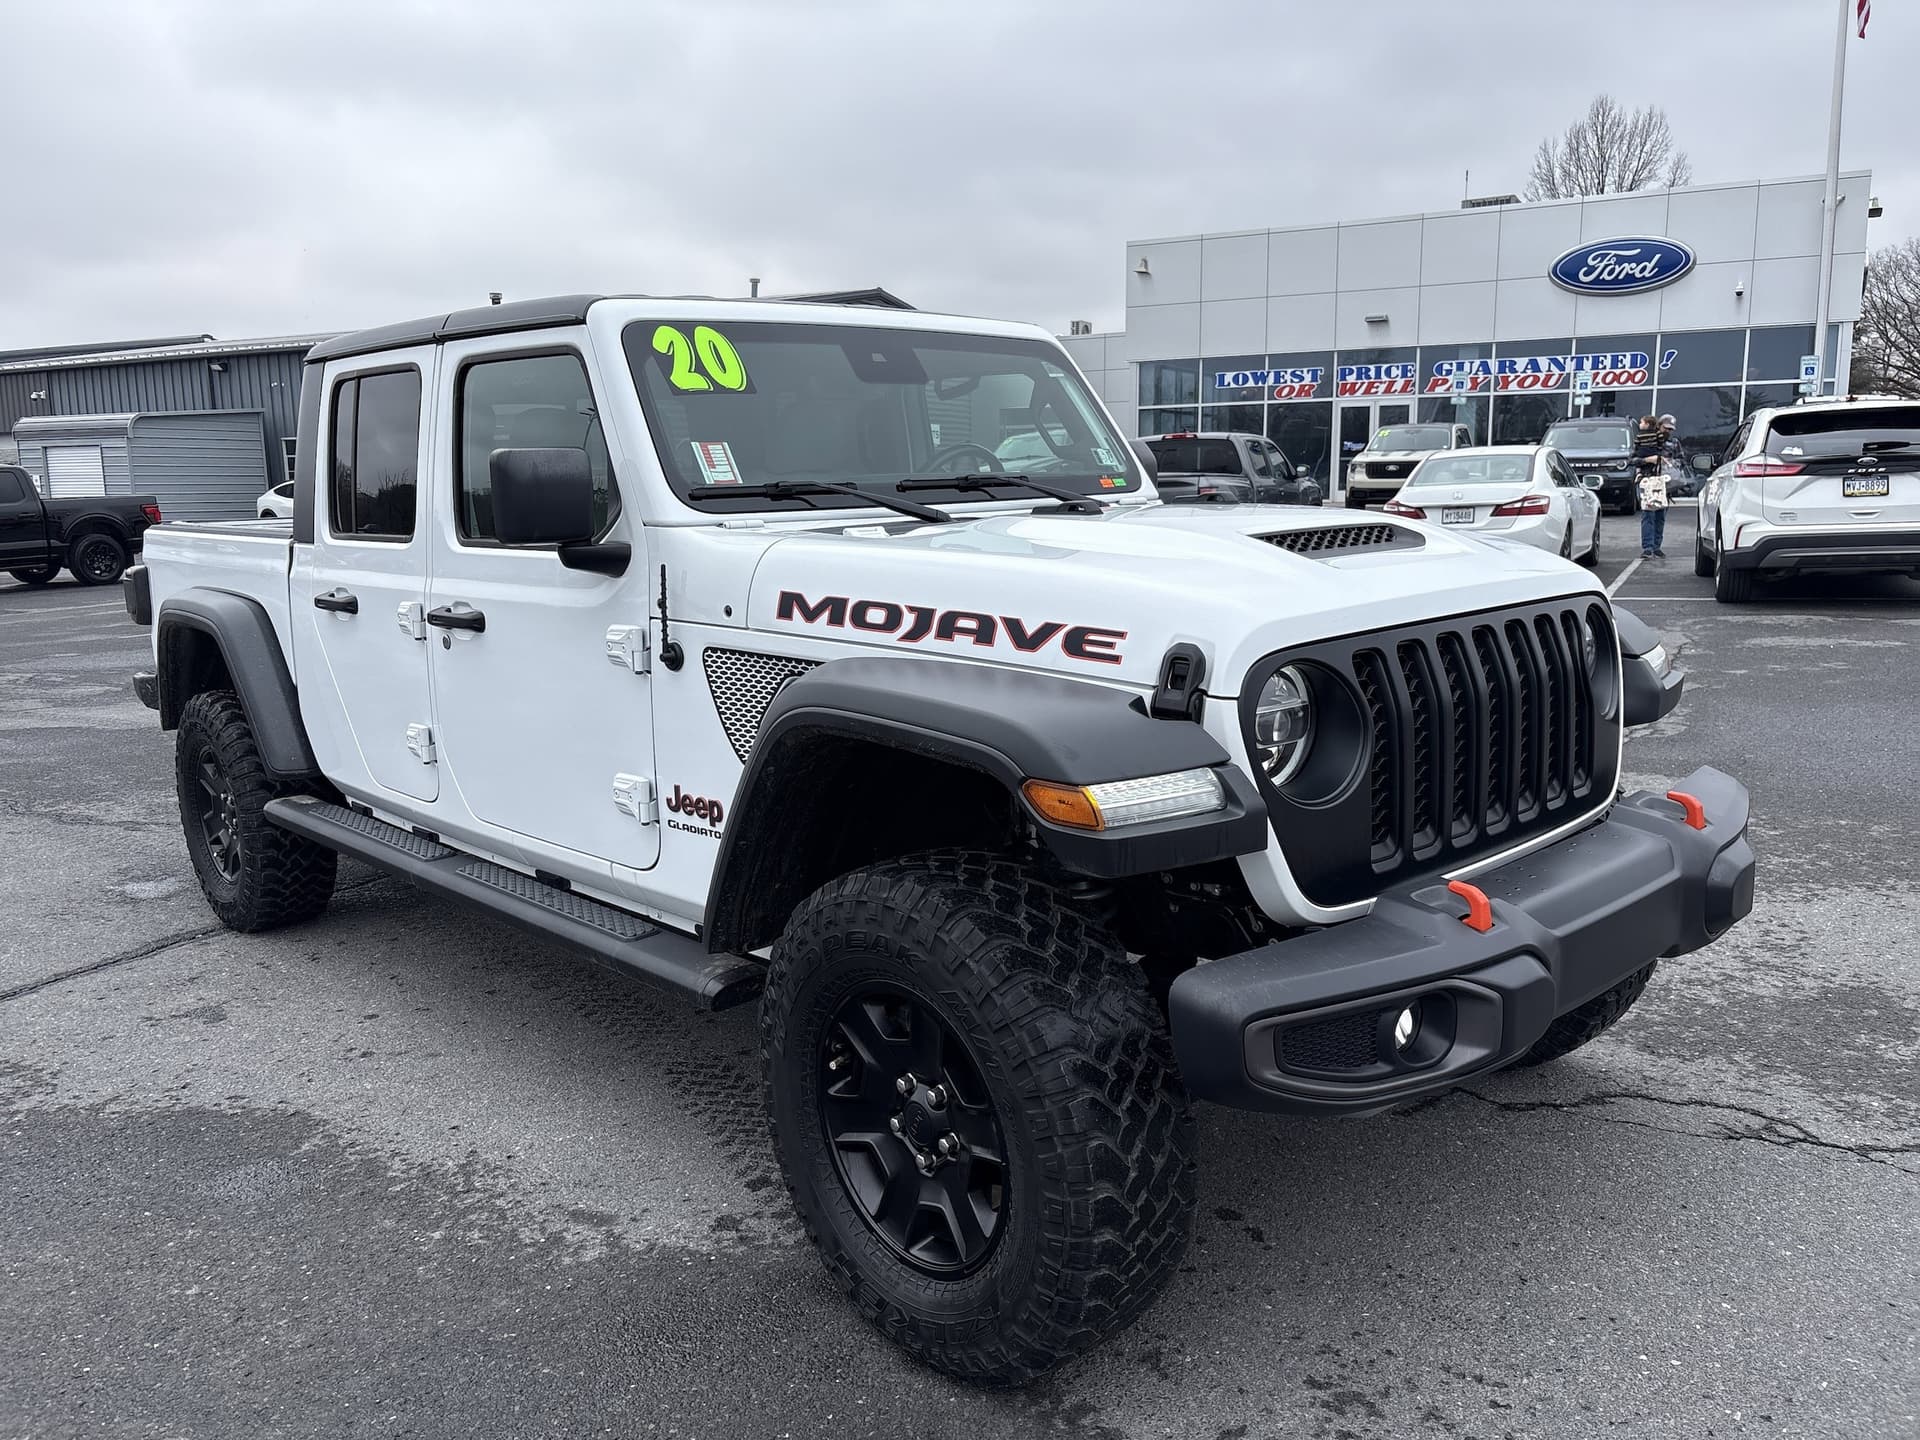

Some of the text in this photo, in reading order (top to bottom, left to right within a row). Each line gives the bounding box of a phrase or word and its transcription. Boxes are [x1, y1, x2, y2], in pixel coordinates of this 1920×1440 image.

[1579, 249, 1661, 282] Ford
[652, 325, 747, 391] 20
[1216, 368, 1324, 388] LOWEST
[1339, 364, 1415, 381] PRICE
[1434, 353, 1648, 376] GUARANTEED
[1274, 384, 1317, 399] OR
[1425, 376, 1489, 393] PY
[1498, 373, 1564, 391] YOU
[776, 590, 1128, 665] MOJAVE
[666, 784, 724, 827] Jeep
[667, 819, 722, 839] GLADIATO
